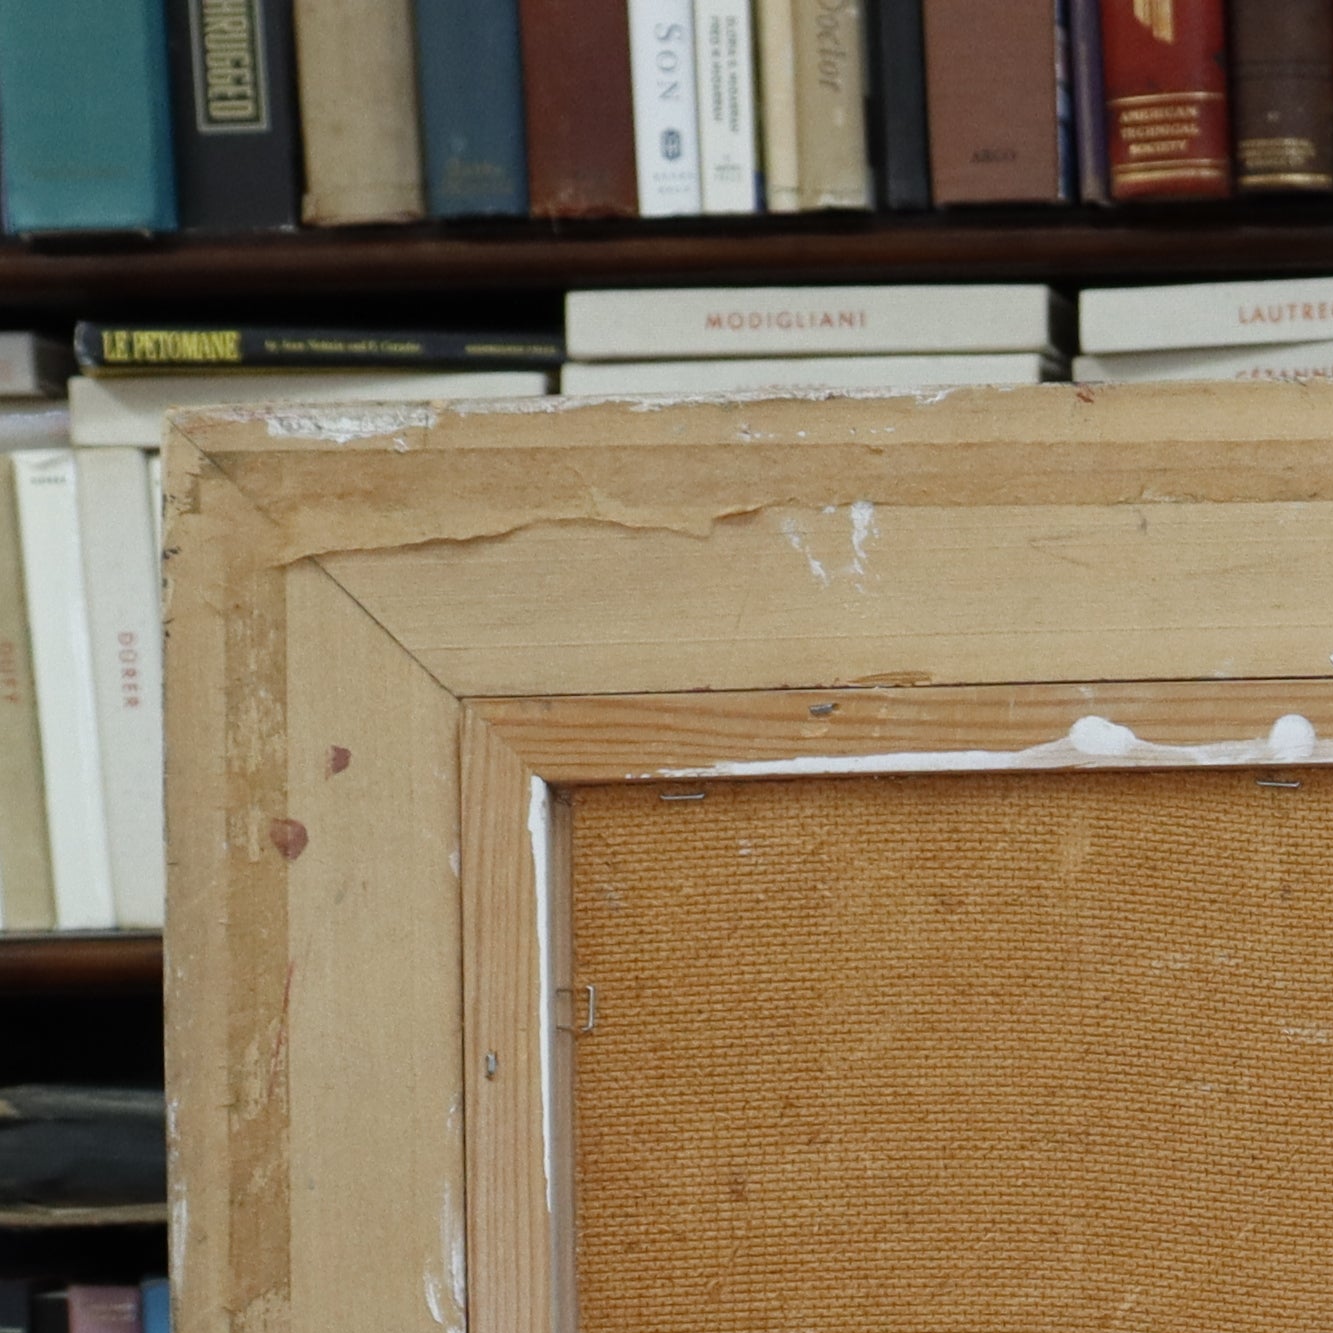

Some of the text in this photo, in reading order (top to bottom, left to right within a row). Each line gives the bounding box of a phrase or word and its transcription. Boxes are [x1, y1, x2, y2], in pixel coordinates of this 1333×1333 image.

[1120, 106, 1198, 124] AMERICAN
[1121, 122, 1200, 139] TECHNICAL
[1129, 138, 1188, 155] SOCIETY
[705, 310, 867, 330] MODIGLIANI
[103, 331, 241, 362] LE PETOMANE
